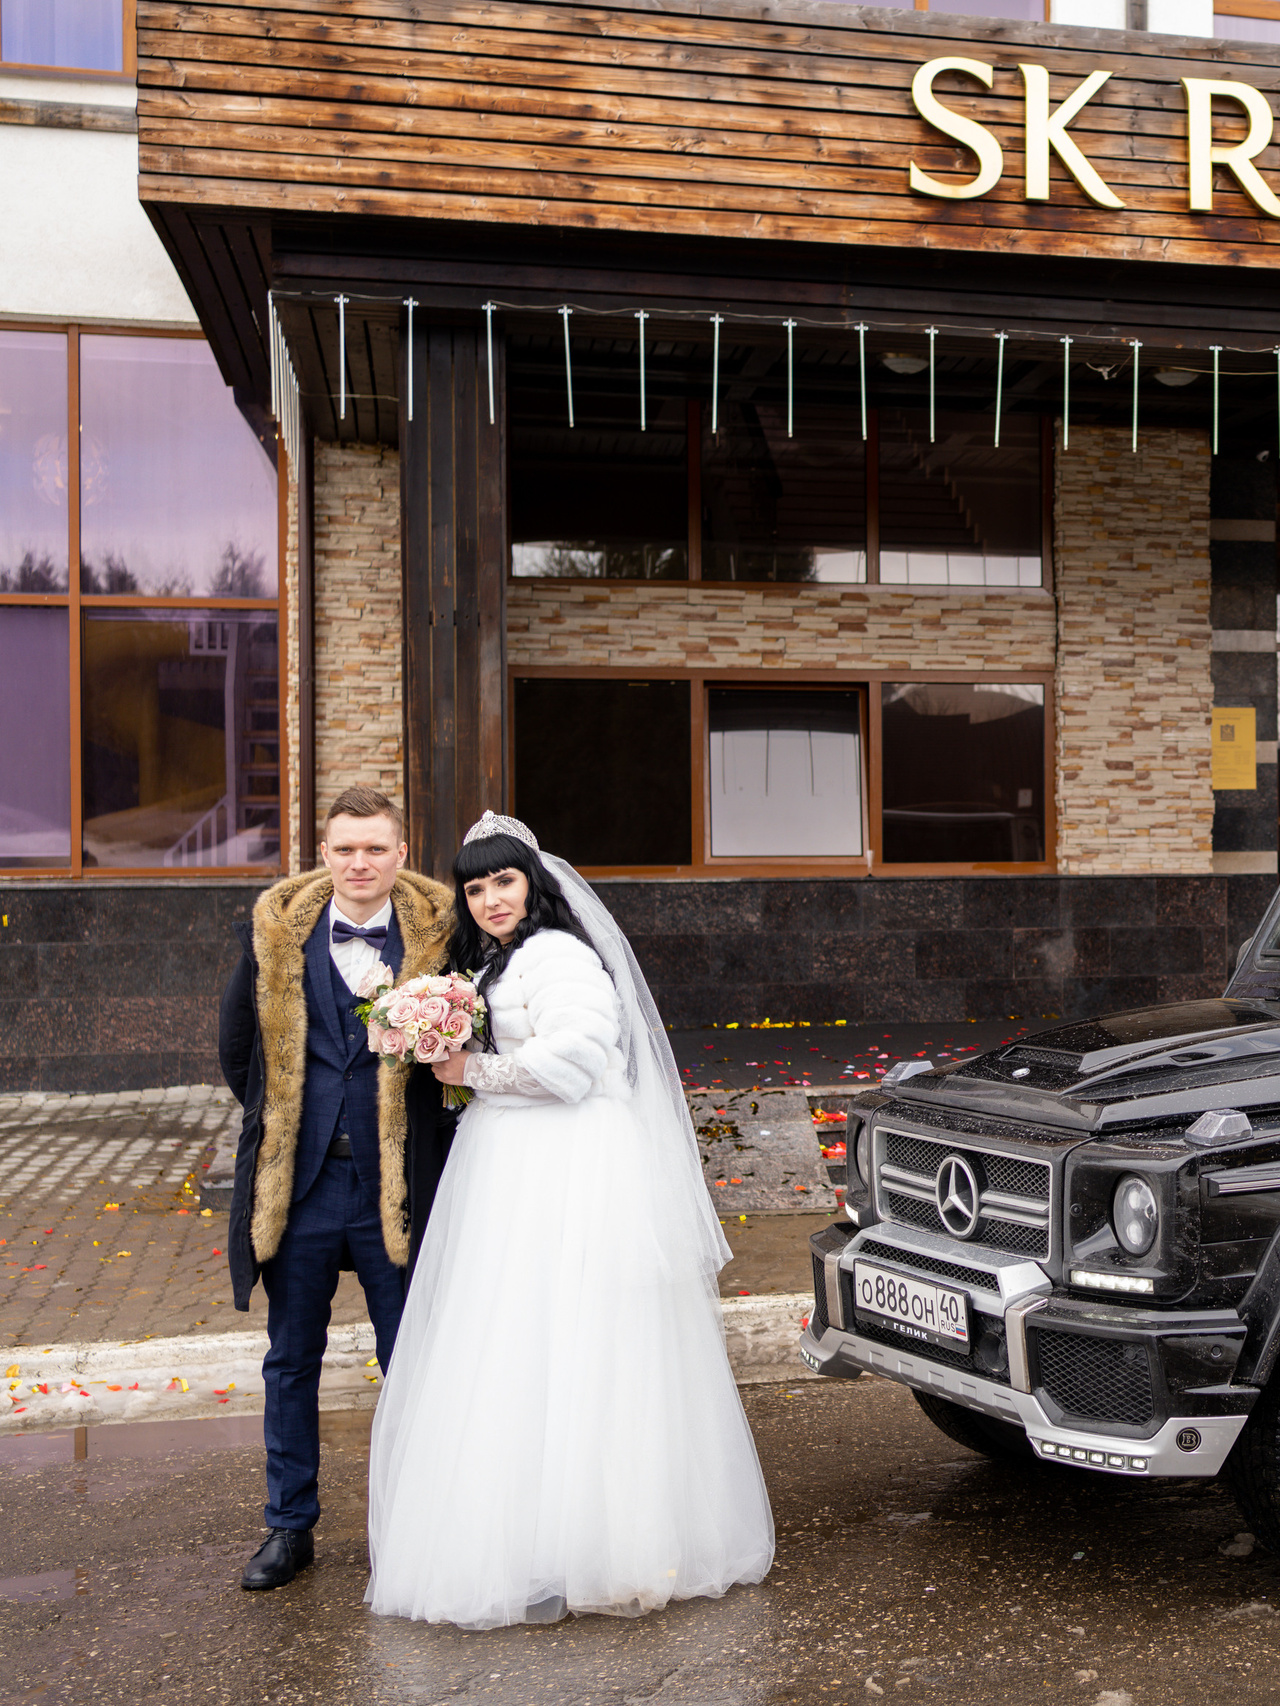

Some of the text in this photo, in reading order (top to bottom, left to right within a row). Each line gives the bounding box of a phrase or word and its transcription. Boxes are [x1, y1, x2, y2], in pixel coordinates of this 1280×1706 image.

[909, 55, 1127, 210] SK
[940, 1293, 959, 1323] 40
[893, 1322, 928, 1340] ГЕЛИК
[940, 1319, 956, 1333] RUS
